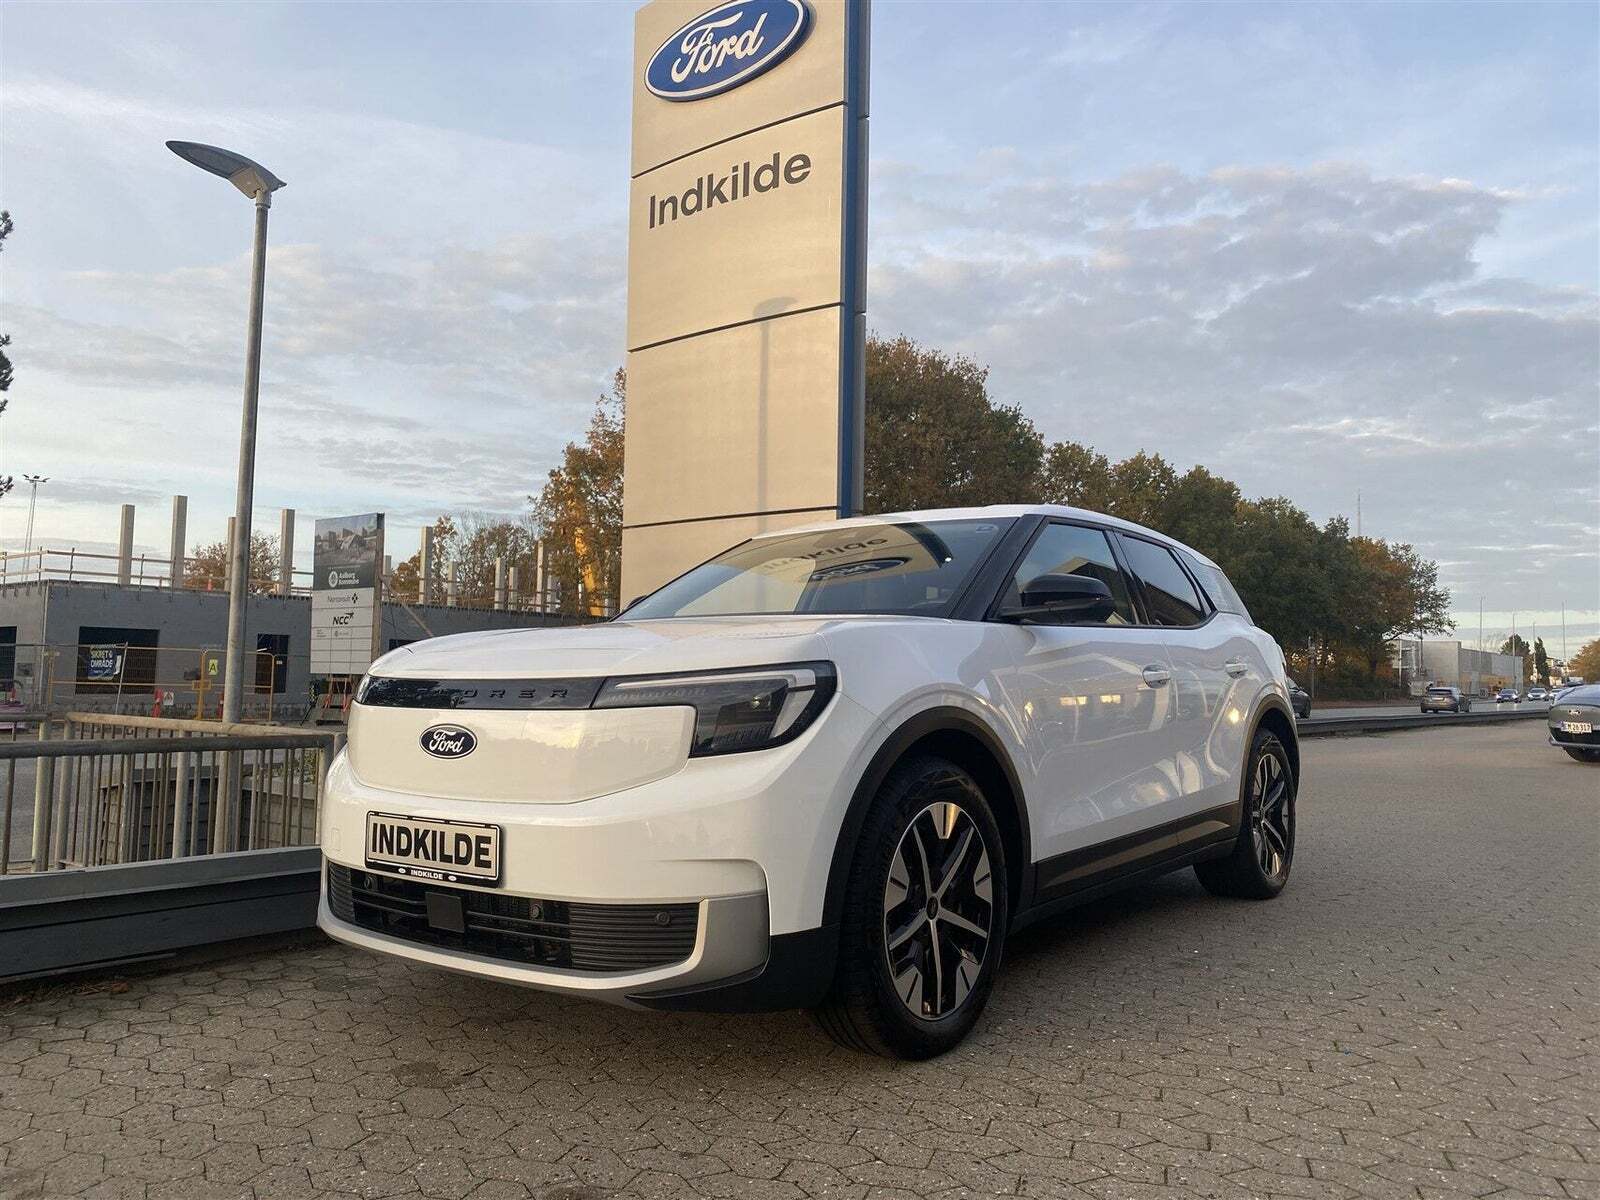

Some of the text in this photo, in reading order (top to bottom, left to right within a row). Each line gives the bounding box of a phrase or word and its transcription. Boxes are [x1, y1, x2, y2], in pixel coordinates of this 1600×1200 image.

[671, 11, 768, 83] Ford
[649, 152, 811, 229] Indkilde
[332, 616, 349, 625] NCC
[428, 729, 463, 752] Ford
[372, 822, 492, 869] INDKILDE
[410, 869, 444, 880] INDKILDE
